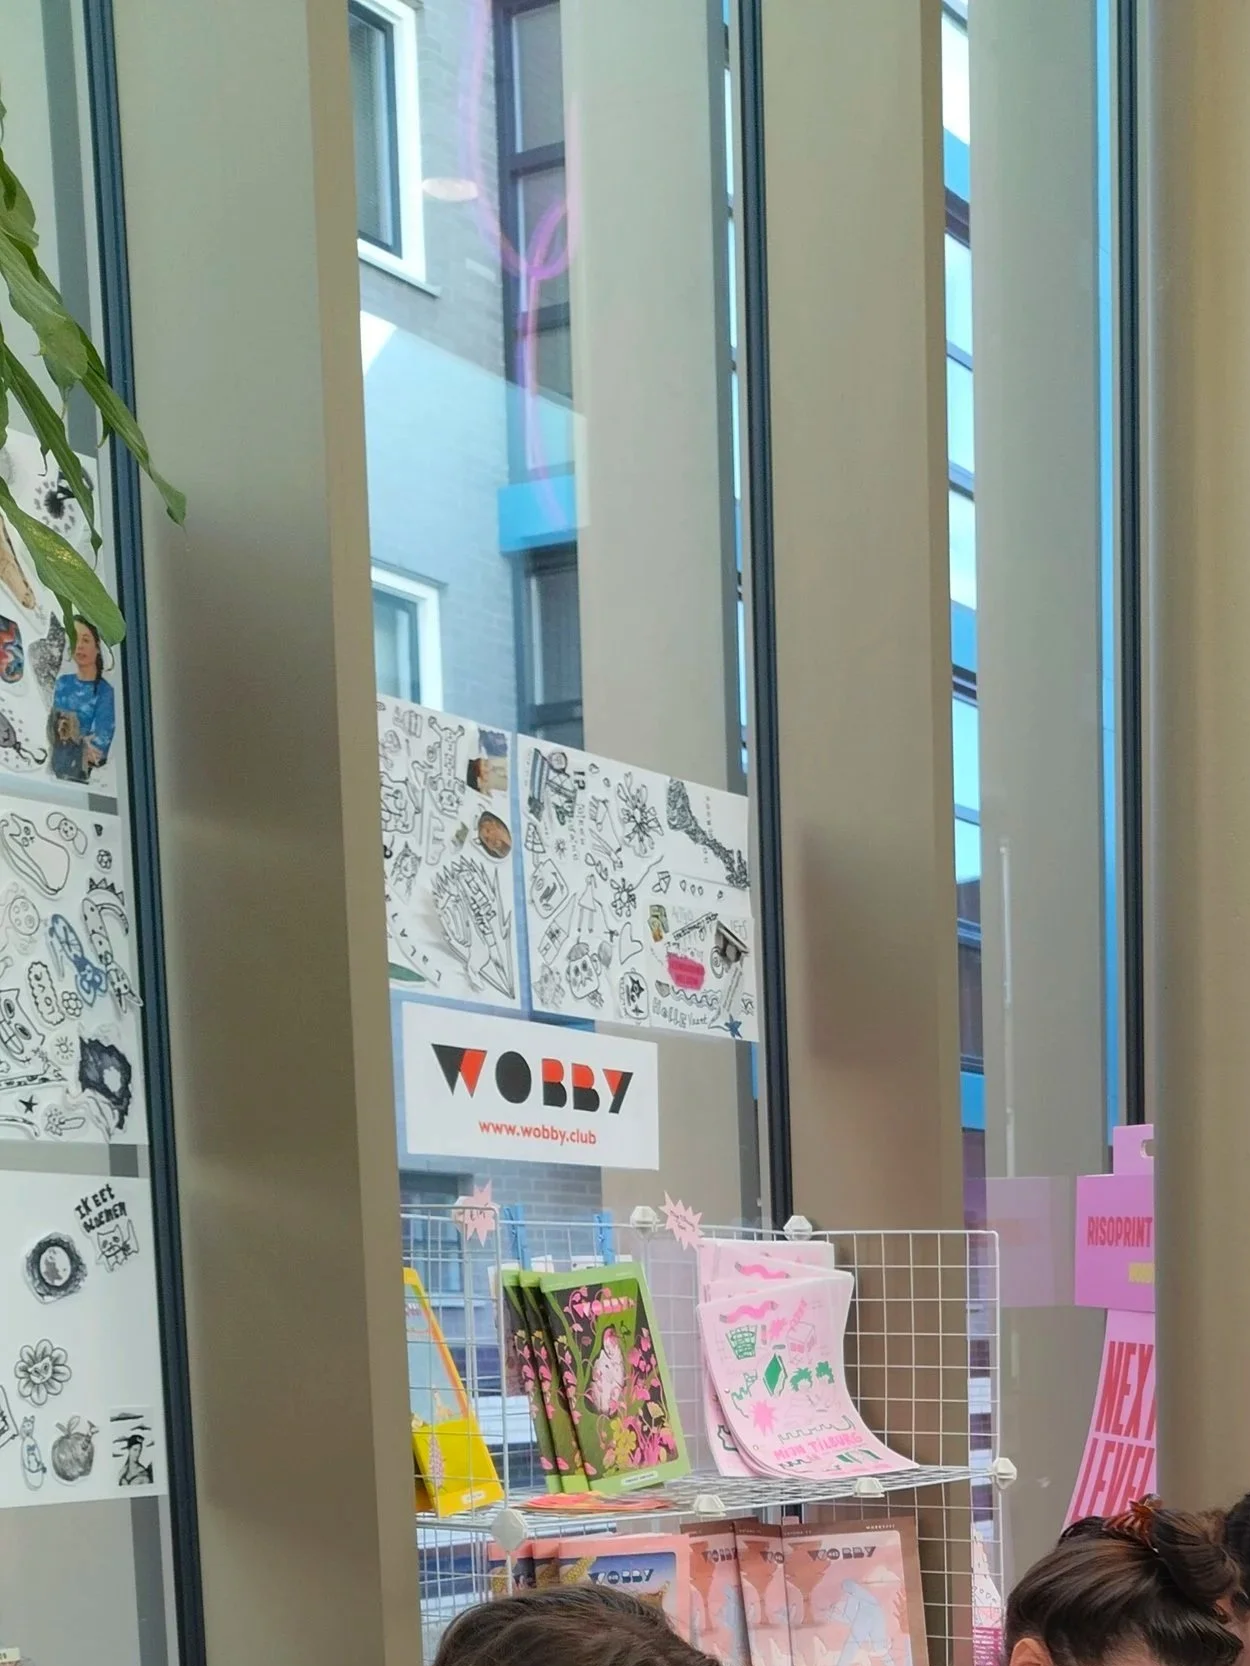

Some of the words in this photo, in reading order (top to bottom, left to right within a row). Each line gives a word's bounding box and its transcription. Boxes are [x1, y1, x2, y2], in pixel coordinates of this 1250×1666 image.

[431, 1043, 634, 1114] WOBBY
[478, 1120, 597, 1146] www.wobby.club
[1087, 1215, 1153, 1248] RISOPRINT
[1095, 1340, 1156, 1442] NEX
[807, 1432, 863, 1451] TILBURG
